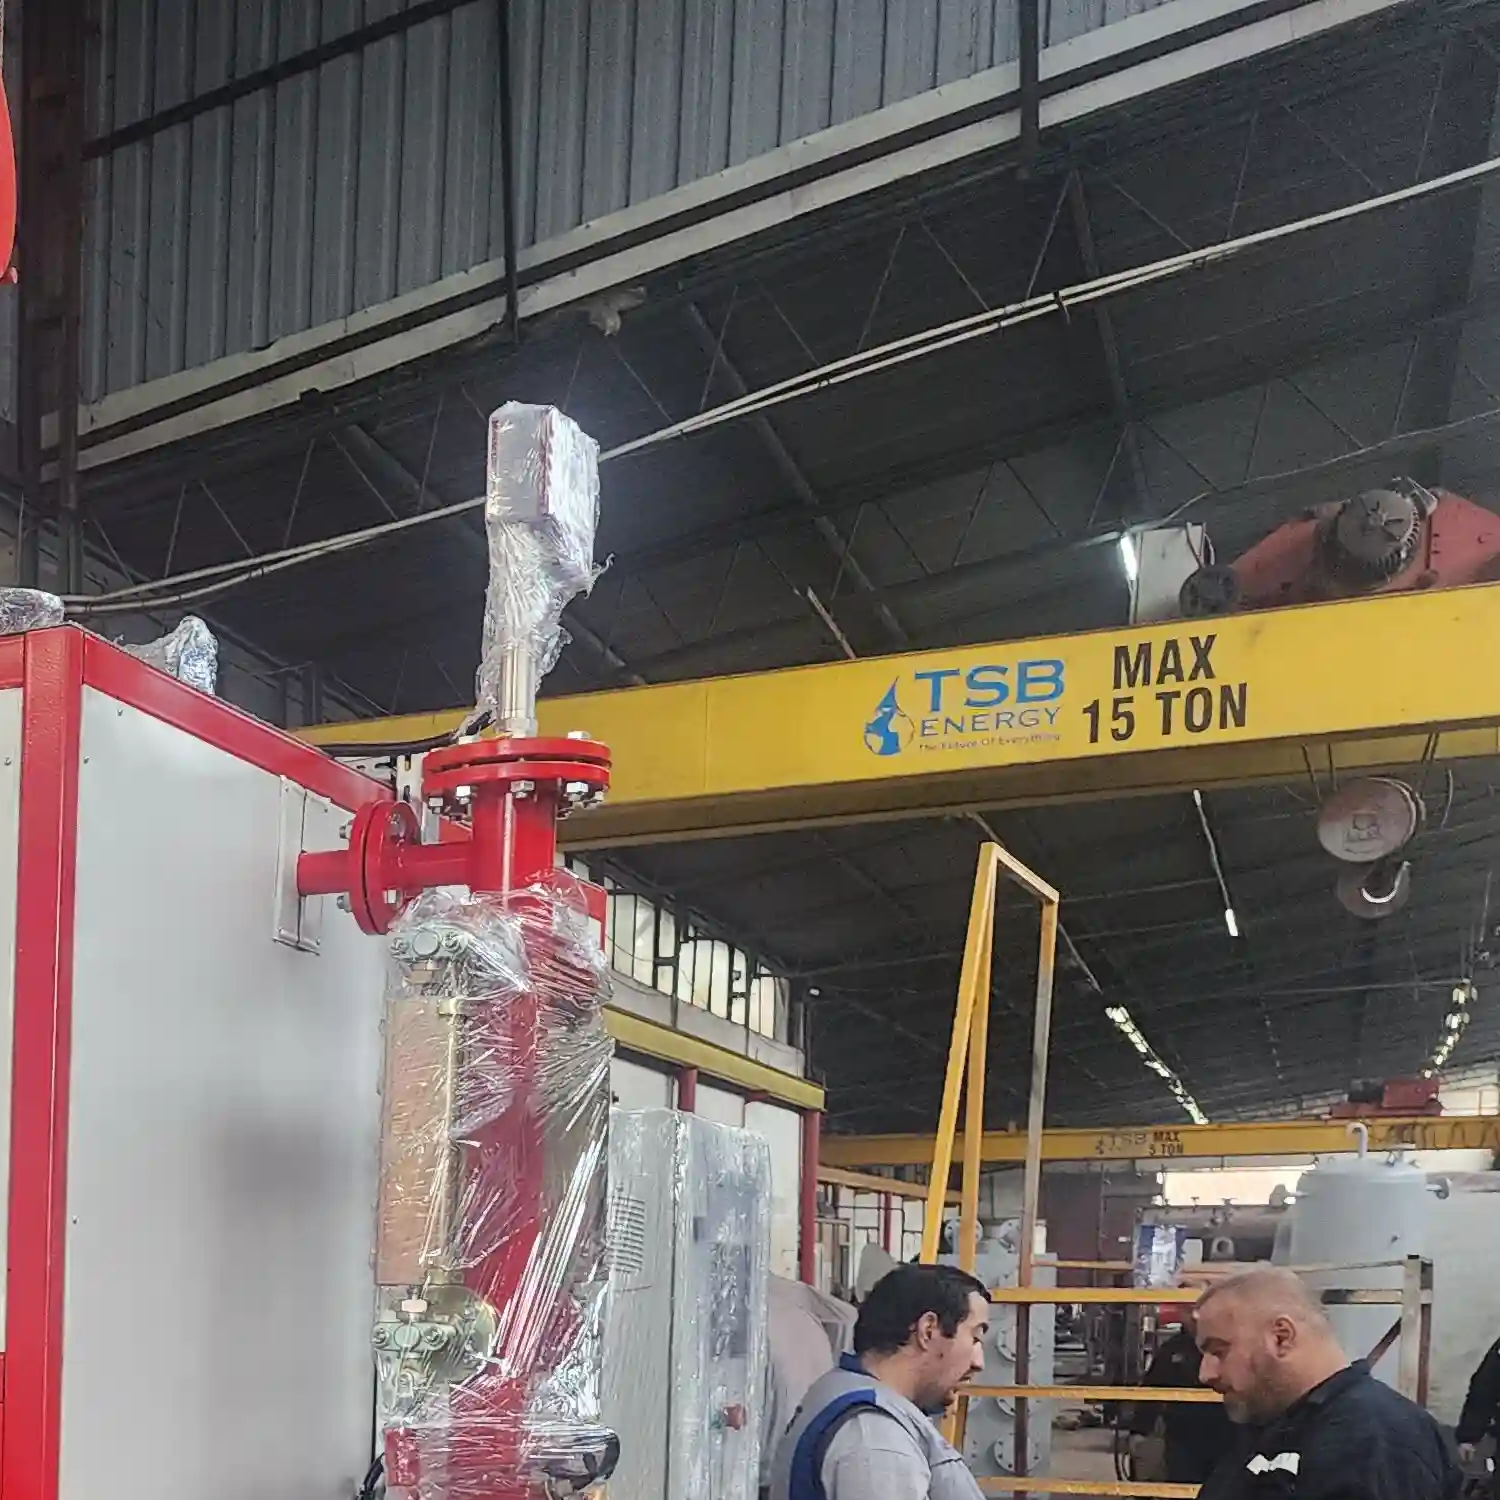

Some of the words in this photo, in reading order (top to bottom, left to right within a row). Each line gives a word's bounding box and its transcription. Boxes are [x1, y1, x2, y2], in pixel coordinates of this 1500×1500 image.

[1113, 633, 1218, 690] MAX
[914, 659, 1065, 712] TSB
[920, 704, 1064, 737] ENERGY
[1082, 696, 1136, 744] 15
[1156, 683, 1248, 736] TON
[1153, 1131, 1180, 1143] MAX
[1161, 1142, 1184, 1155] TON
